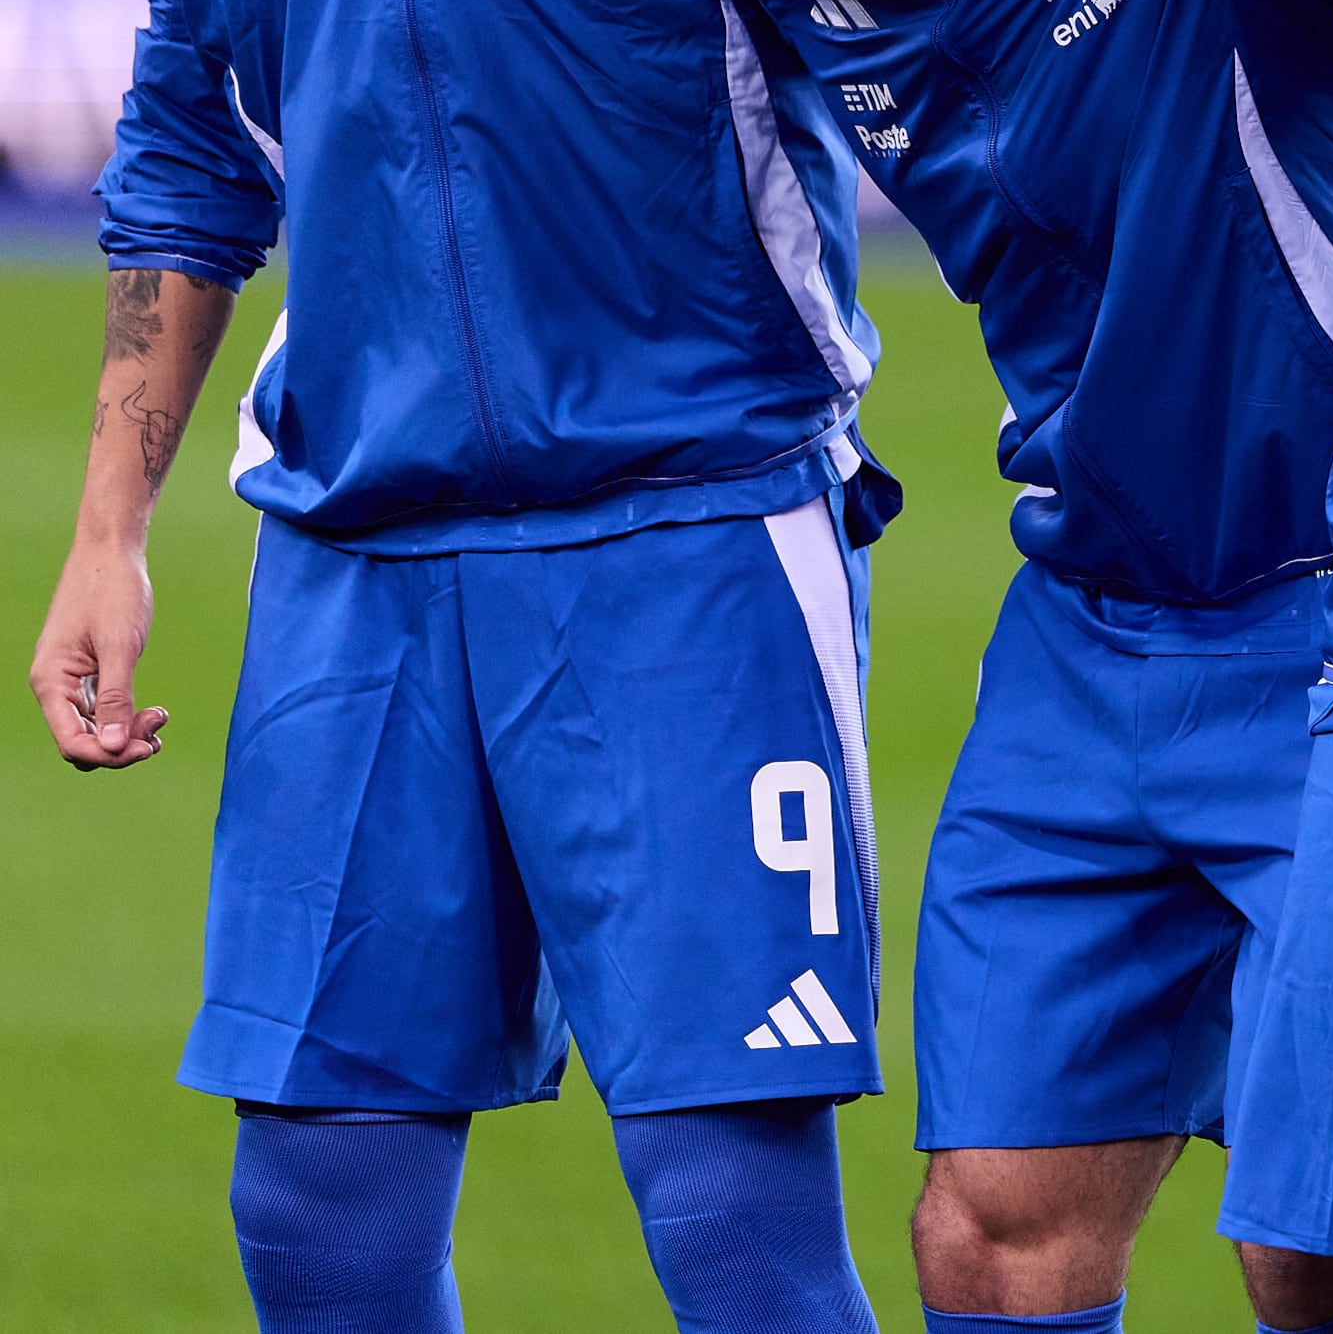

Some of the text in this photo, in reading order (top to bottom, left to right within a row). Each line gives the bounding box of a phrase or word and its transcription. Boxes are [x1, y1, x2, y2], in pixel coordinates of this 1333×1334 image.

[858, 83, 898, 111] TIM
[854, 123, 911, 150] Poste
[751, 760, 839, 935] 9
